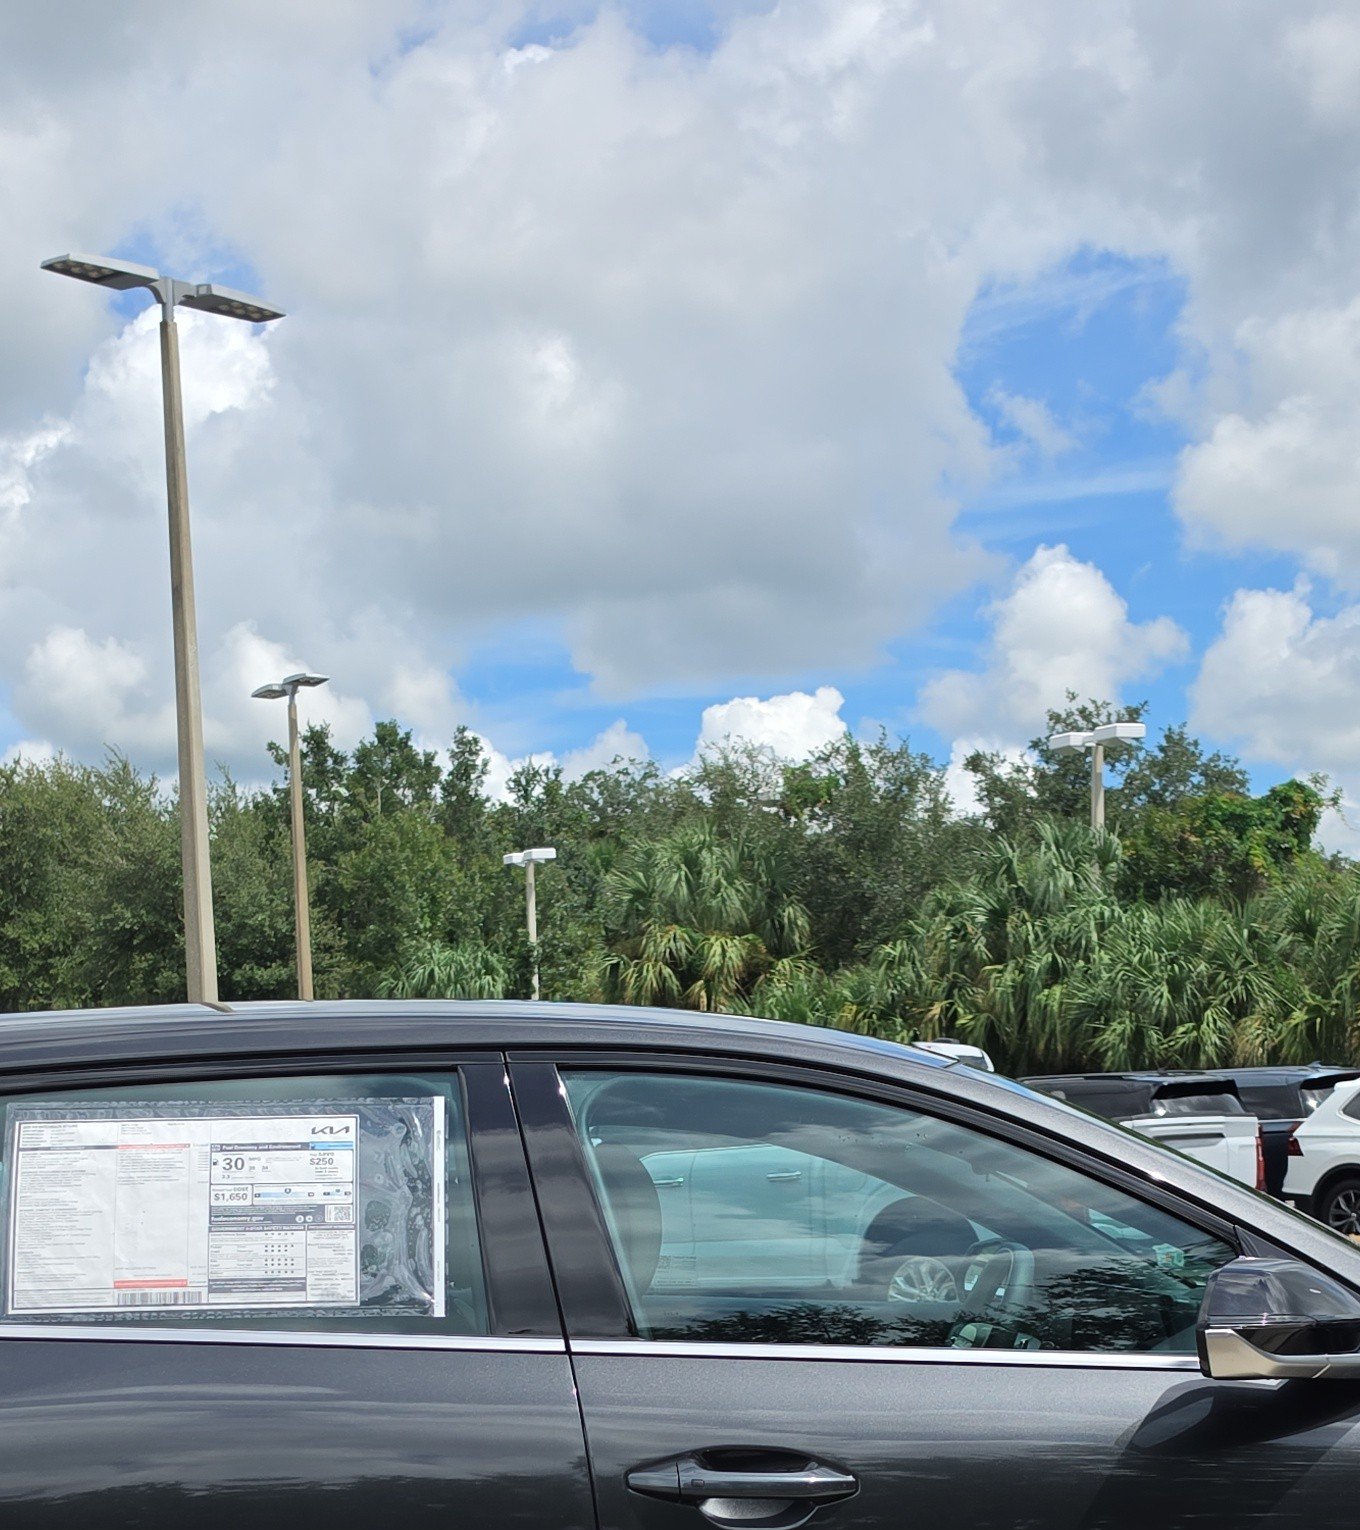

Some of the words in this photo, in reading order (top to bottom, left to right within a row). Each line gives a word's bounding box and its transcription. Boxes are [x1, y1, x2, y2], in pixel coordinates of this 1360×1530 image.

[311, 1126, 350, 1135] KIA
[222, 1157, 245, 1171] 30
[309, 1158, 334, 1166] $250
[214, 1193, 248, 1202] $1,650
